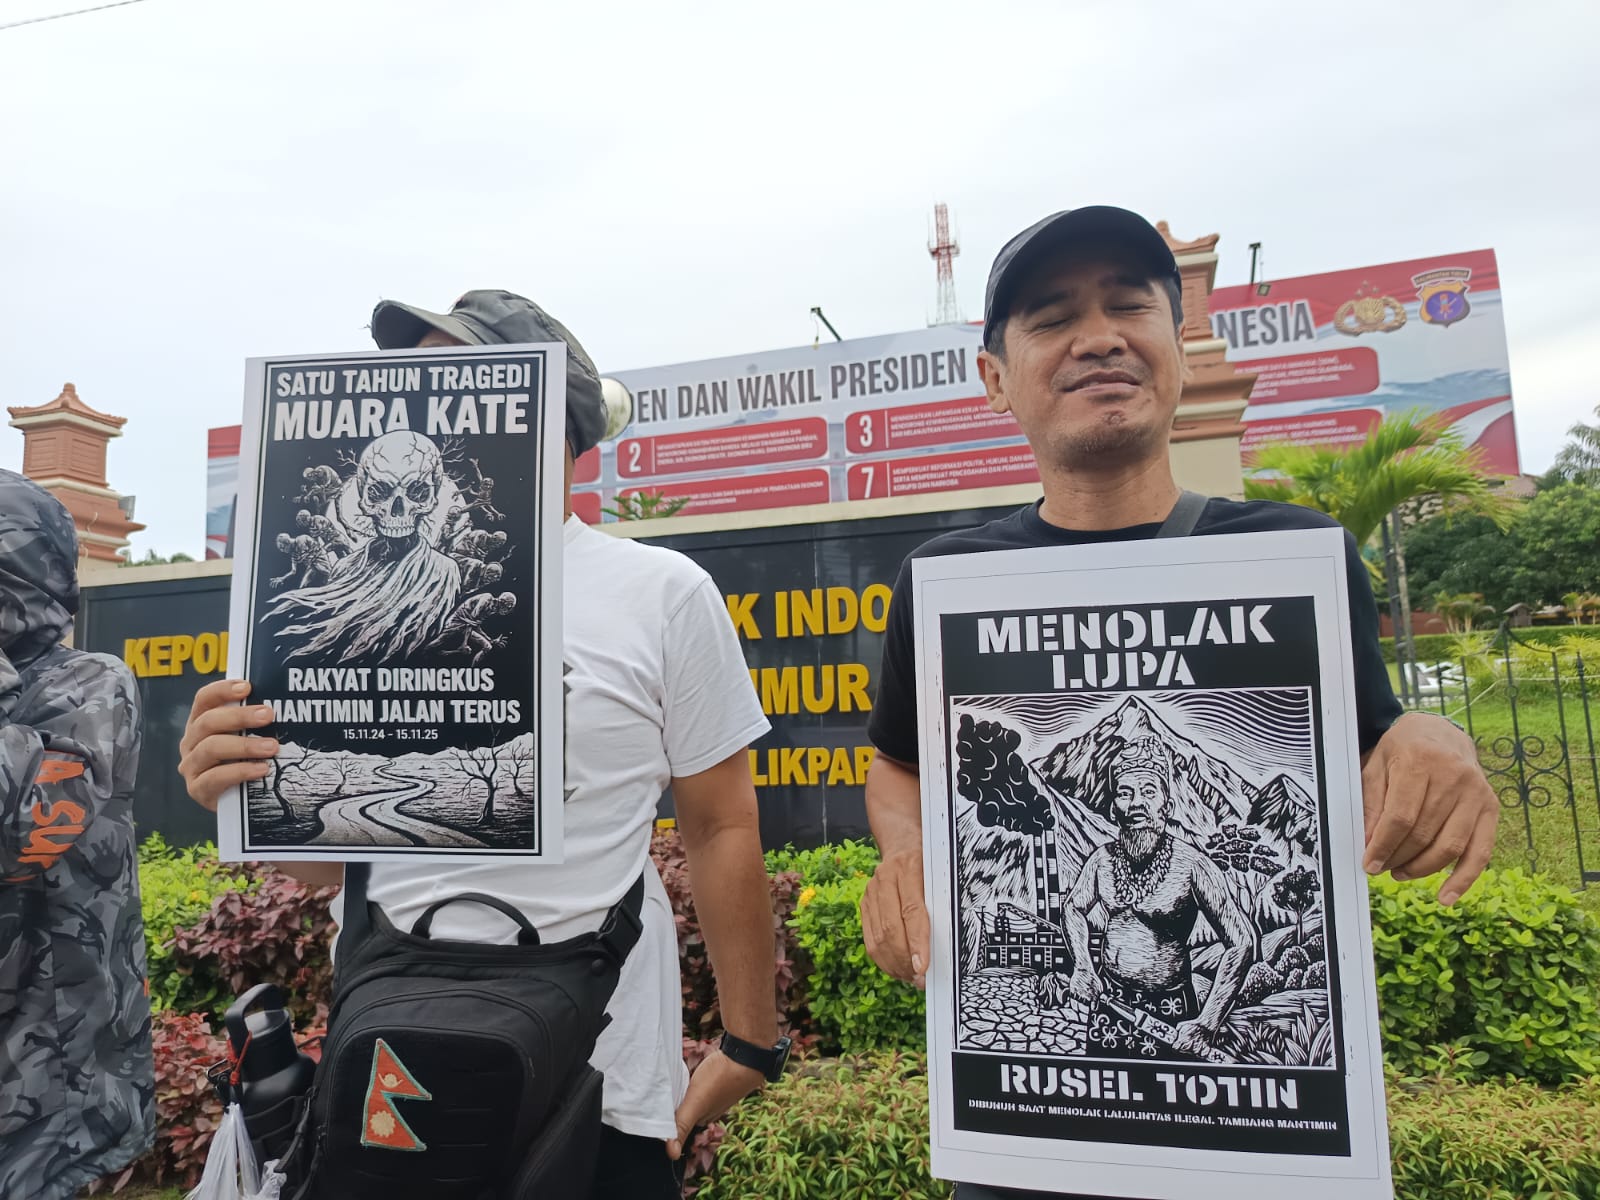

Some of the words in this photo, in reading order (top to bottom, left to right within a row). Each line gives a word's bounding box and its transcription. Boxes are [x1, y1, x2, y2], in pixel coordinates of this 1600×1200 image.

[1208, 303, 1314, 348] NESIA
[277, 370, 335, 397] SATU
[342, 368, 421, 394] TAHUN
[428, 363, 531, 391] TRAGEDI
[629, 388, 667, 424] EN
[678, 380, 728, 419] DAN
[737, 369, 821, 411] WAKIL
[831, 348, 966, 399] PRESIDEN
[274, 397, 410, 441] MUARA
[427, 393, 530, 435] KATE
[859, 415, 874, 447] 3
[629, 442, 641, 472] 2
[861, 467, 874, 499] 7
[775, 583, 893, 638] INDO
[977, 604, 1276, 654] MENOLAK
[288, 668, 371, 692] RAKYAT
[377, 668, 495, 692] DIRINGKUS
[1052, 650, 1196, 689] LUPA
[750, 663, 873, 715] MUR
[263, 699, 374, 723] MANTIMIN
[379, 699, 444, 723] JALAN
[450, 699, 521, 724] TERUS
[343, 728, 385, 740] 15.11.24
[396, 728, 439, 740] 15.11.25
[1000, 1063, 1143, 1101] RUSEL
[1155, 1072, 1298, 1110] TOTIN
[968, 1099, 1016, 1112] DIBUNUH
[1018, 1103, 1046, 1114] SAAT
[1048, 1105, 1101, 1118] MENOLAK
[1174, 1113, 1215, 1125] ILEGAL
[1217, 1116, 1274, 1128] TAMBANG
[1277, 1118, 1337, 1131] MANTIMIN
